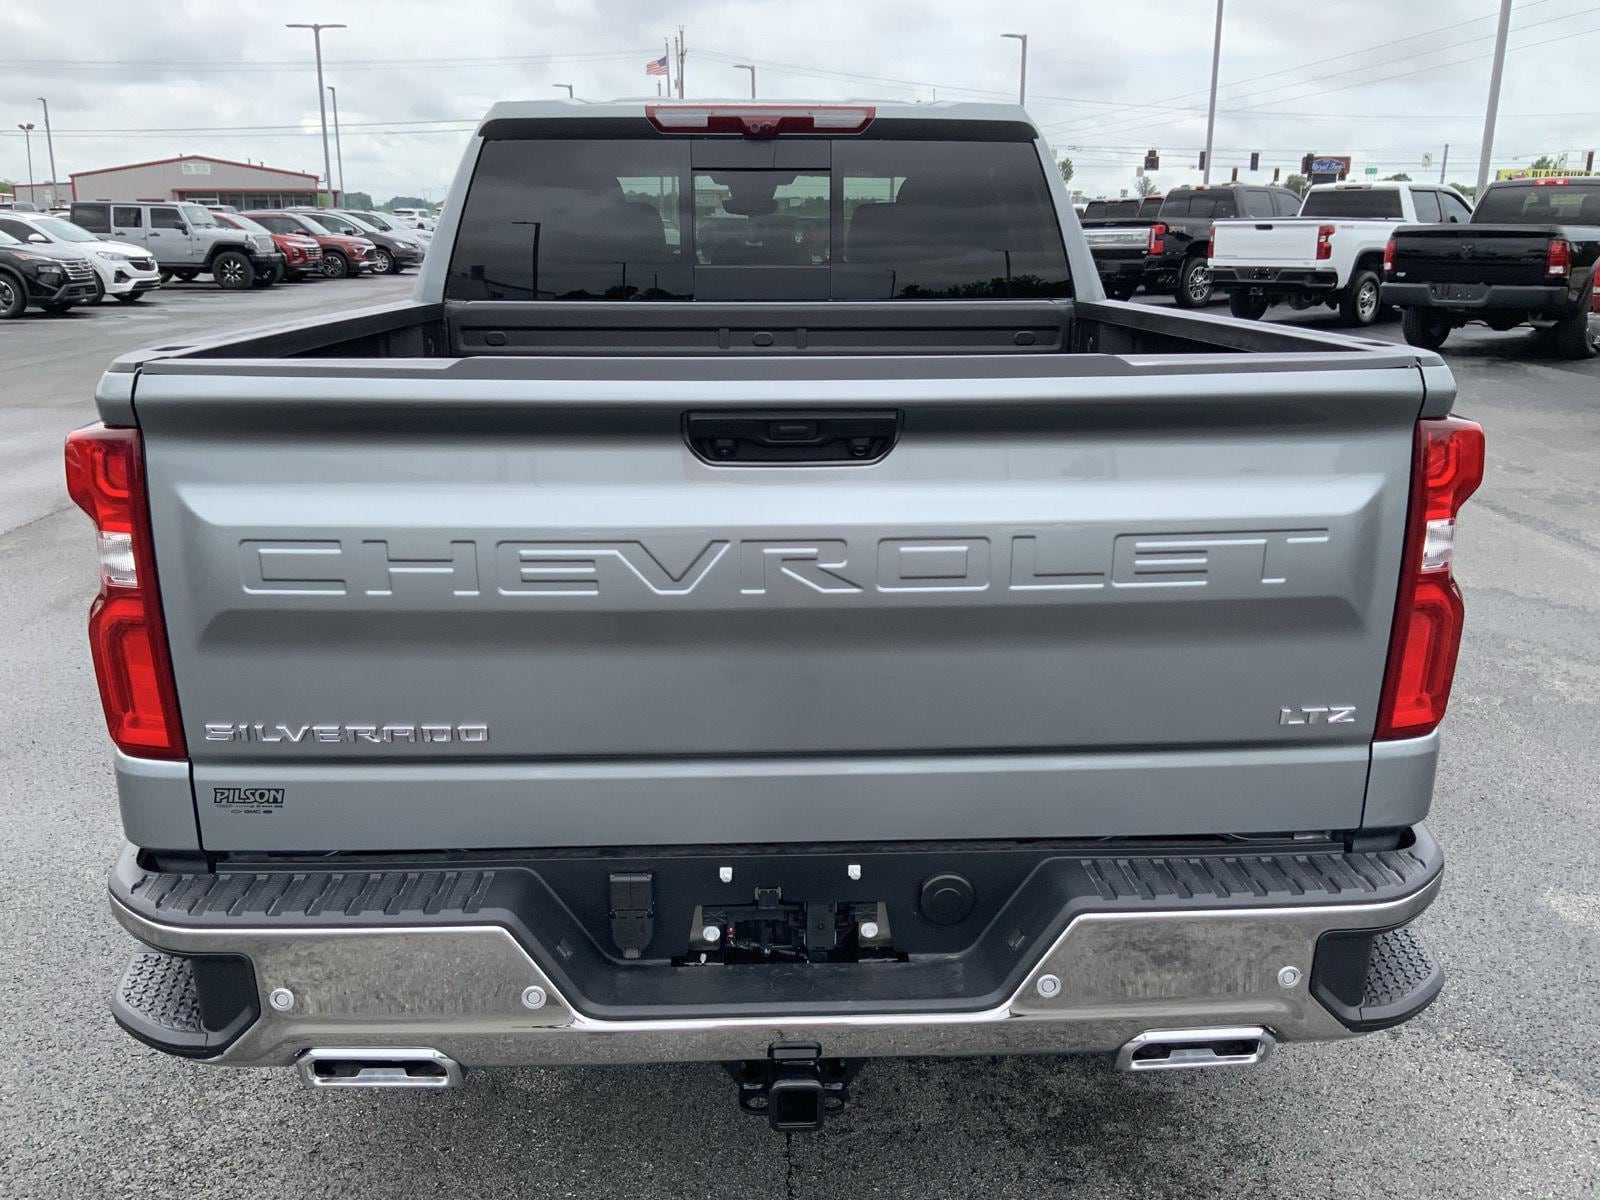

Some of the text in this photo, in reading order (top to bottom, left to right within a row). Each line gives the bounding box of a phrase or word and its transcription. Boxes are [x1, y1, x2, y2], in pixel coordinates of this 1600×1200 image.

[238, 527, 1330, 597] CHEVROLET
[1279, 705, 1357, 726] LTZ
[204, 722, 490, 744] SILVERADO
[213, 787, 285, 805] PILSON
